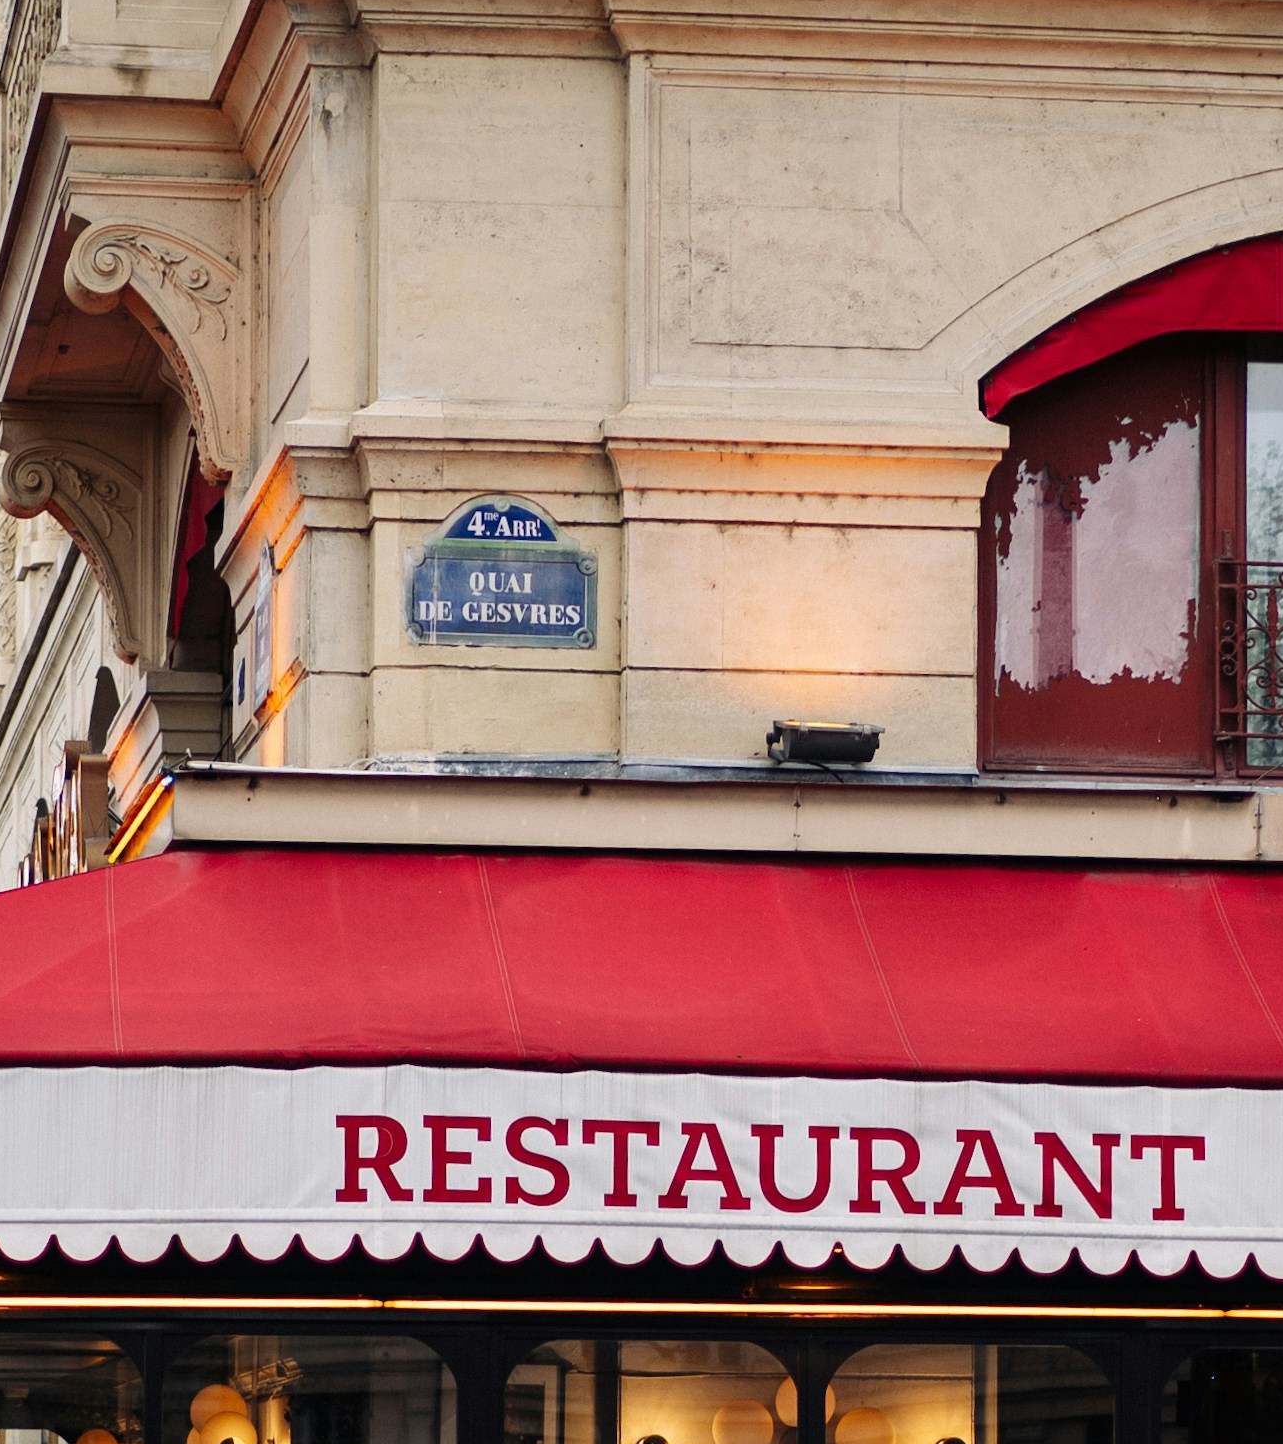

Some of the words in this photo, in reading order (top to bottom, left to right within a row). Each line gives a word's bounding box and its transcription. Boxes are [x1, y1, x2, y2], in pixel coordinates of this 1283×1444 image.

[469, 571, 533, 596] QUAI
[419, 601, 453, 622] DE
[462, 603, 582, 625] GESVRES
[334, 1114, 1207, 1221] RESTAURANT
